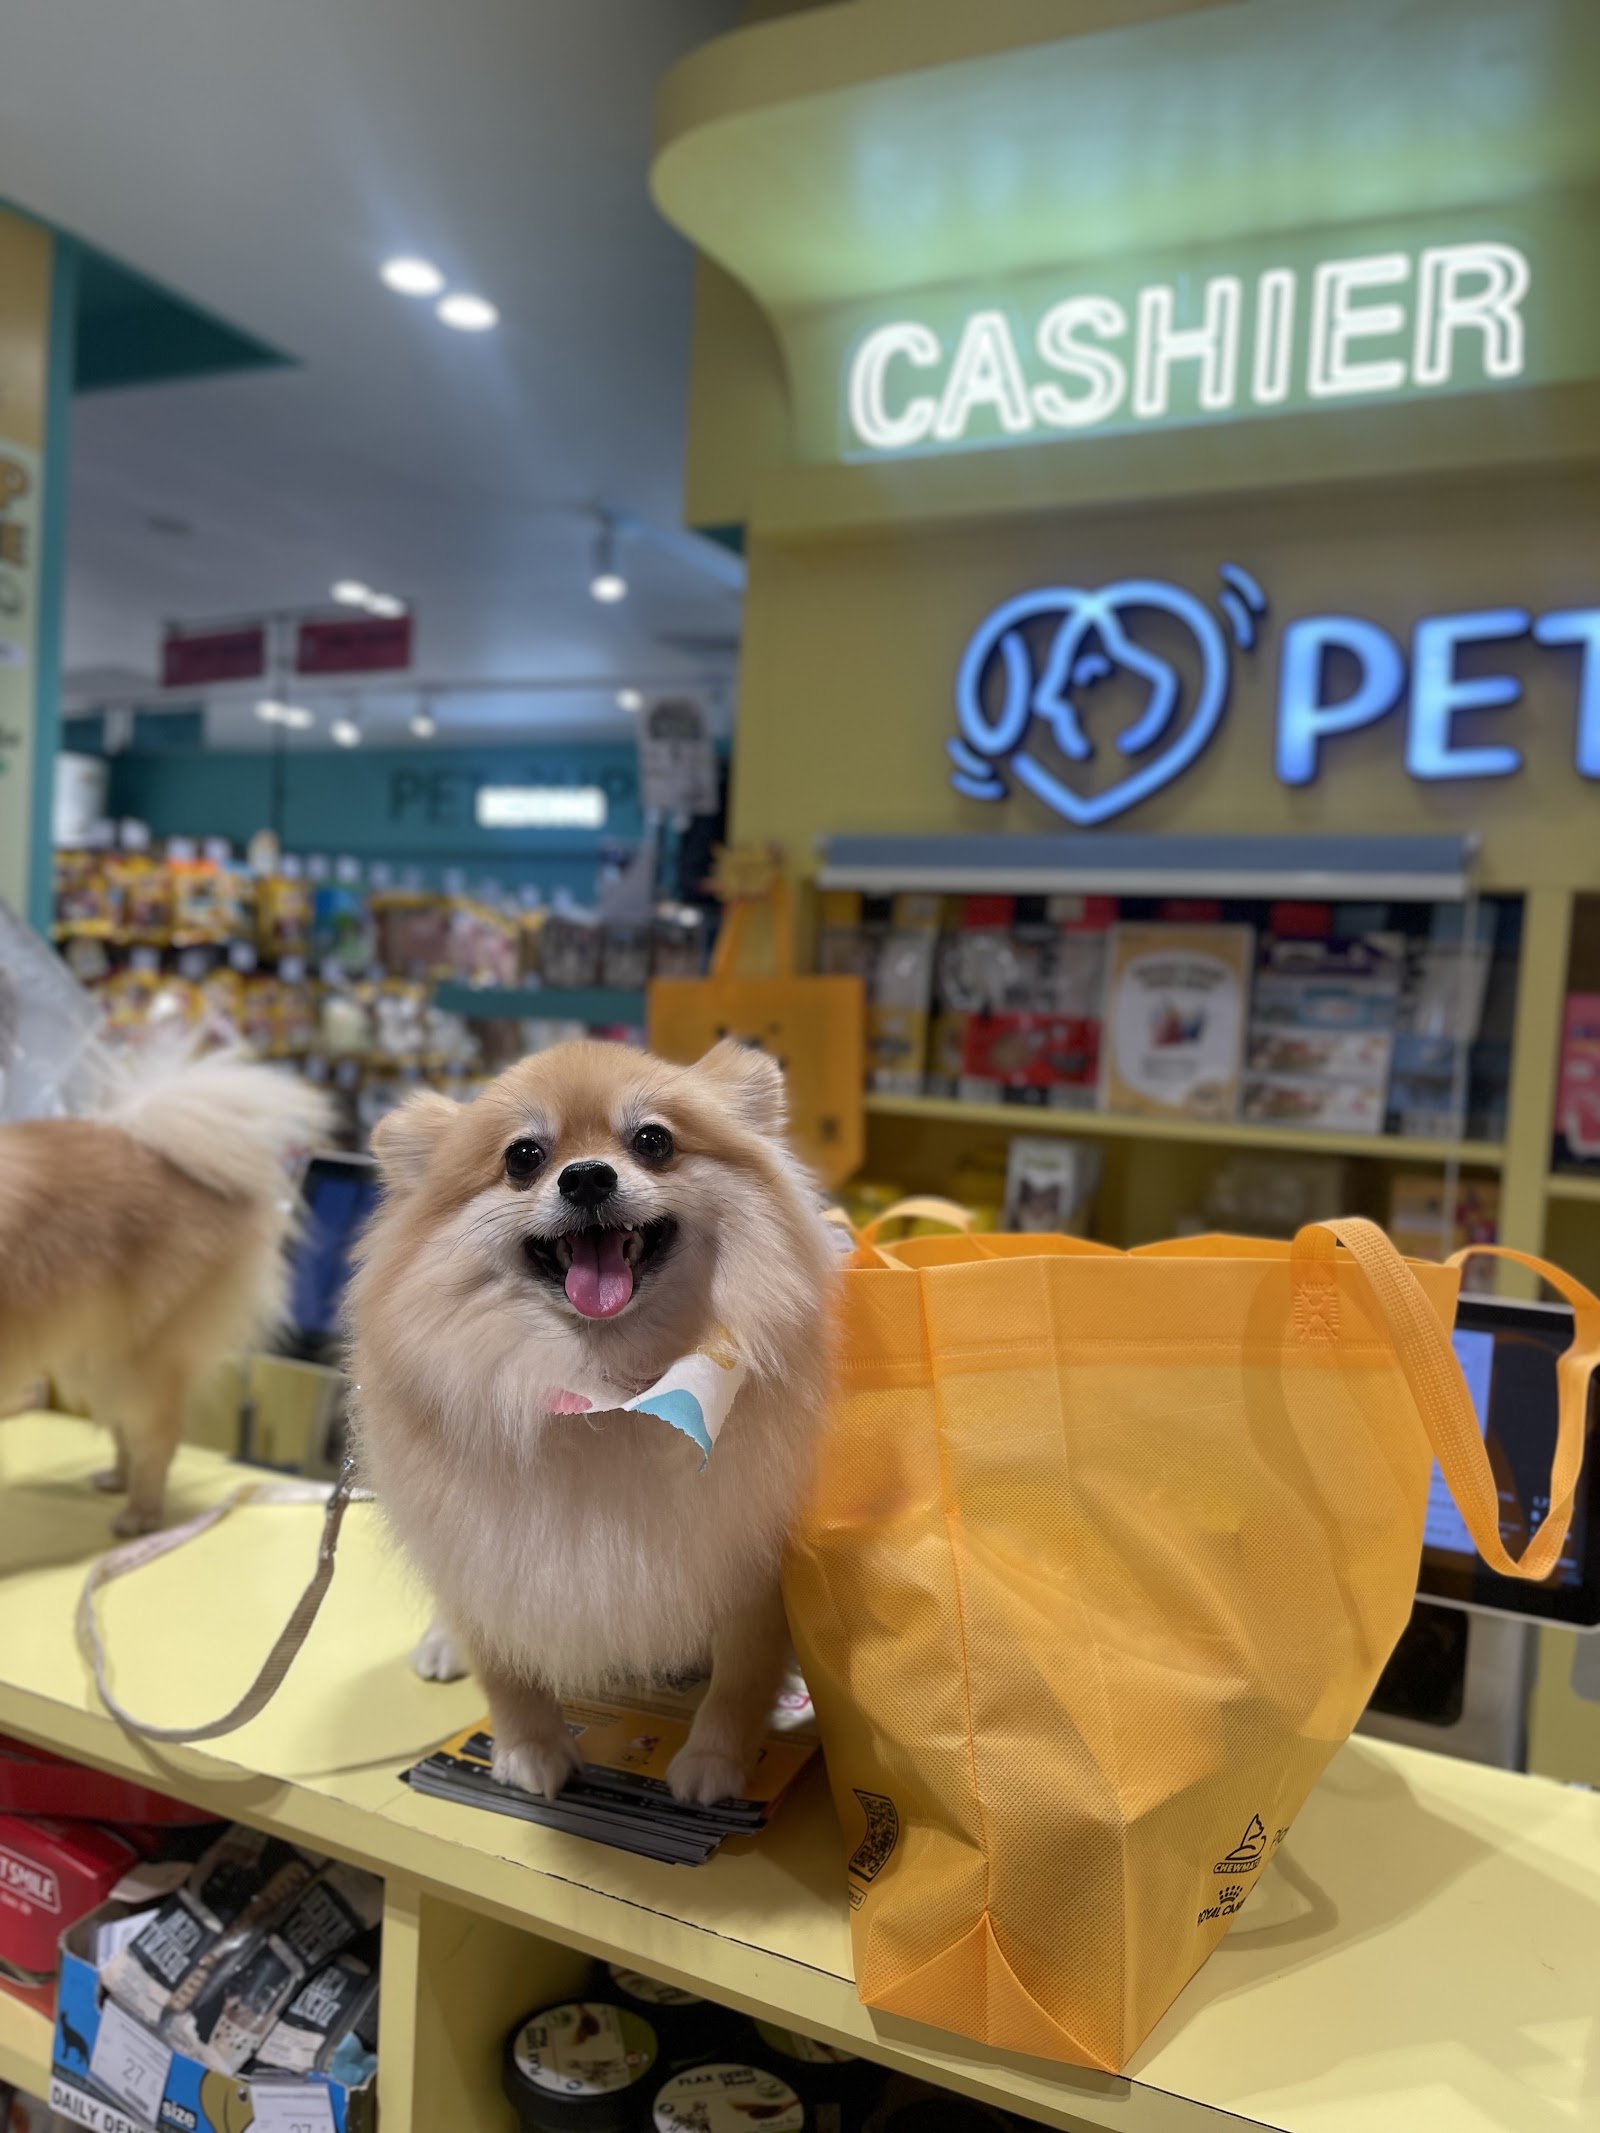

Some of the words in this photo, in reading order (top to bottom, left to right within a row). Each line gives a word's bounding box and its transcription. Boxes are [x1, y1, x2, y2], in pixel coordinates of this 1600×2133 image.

[849, 243, 1529, 448] CASHIER
[121, 2056, 146, 2087] 27
[51, 2086, 99, 2125] DAILY
[161, 2100, 196, 2130] size
